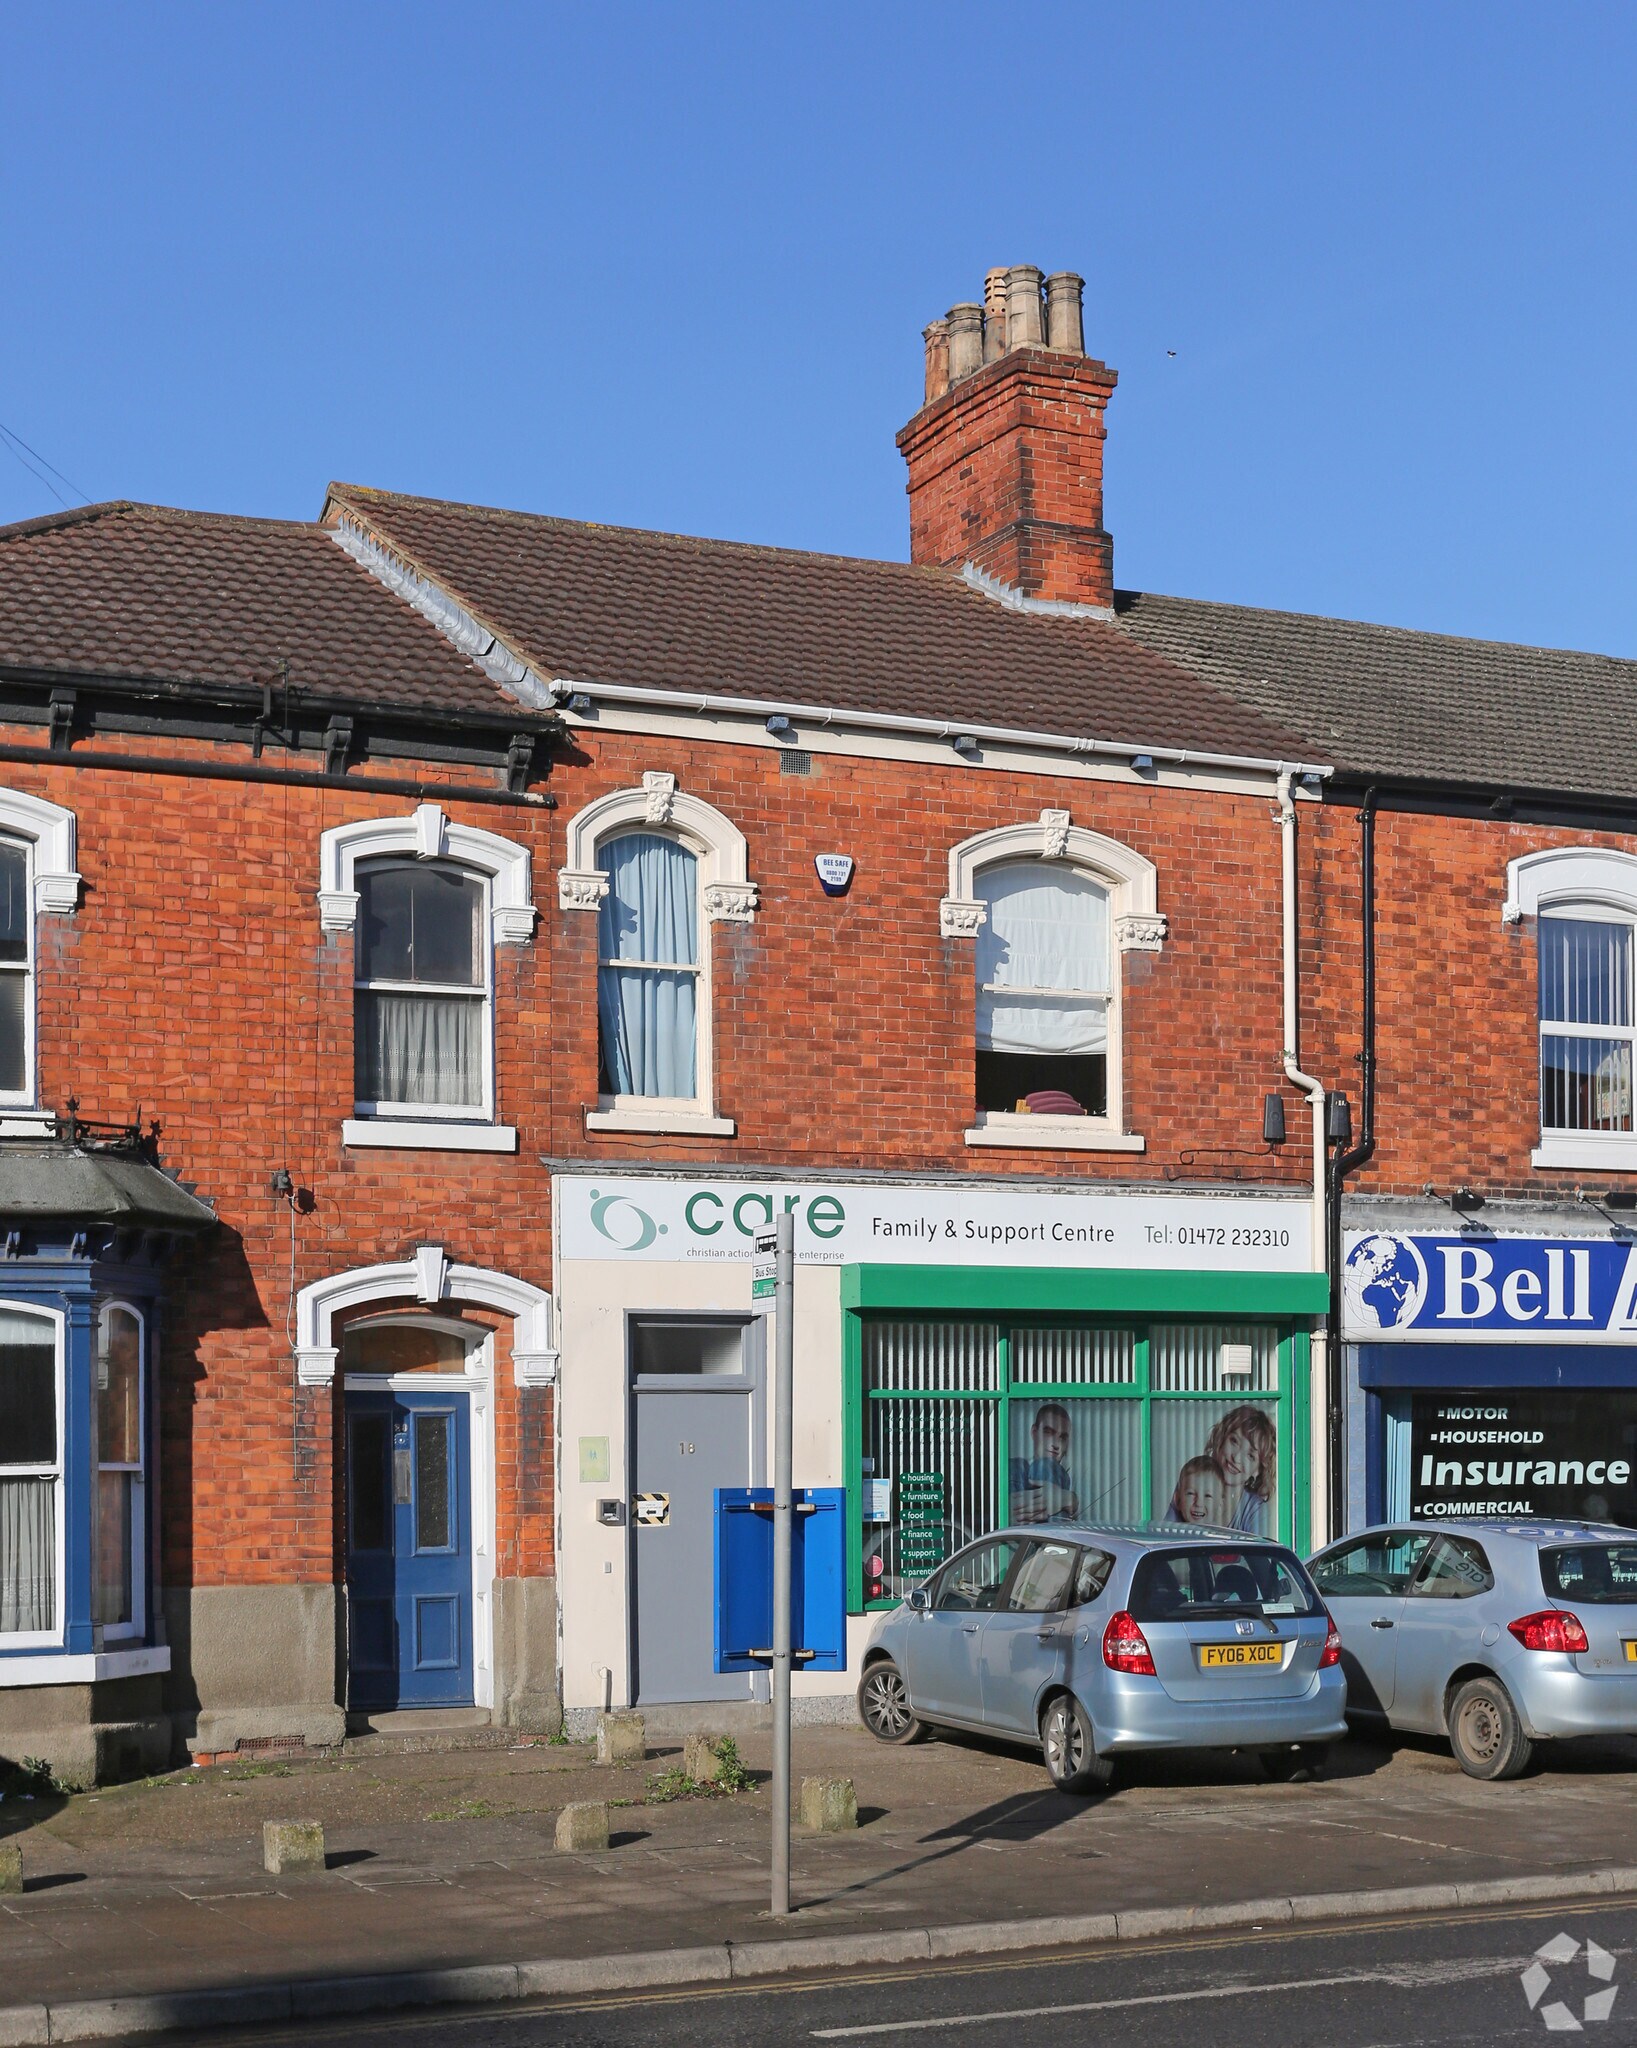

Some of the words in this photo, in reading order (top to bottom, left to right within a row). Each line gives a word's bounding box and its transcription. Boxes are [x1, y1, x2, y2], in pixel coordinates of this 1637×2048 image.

[835, 860, 849, 868] SAFE
[685, 1191, 846, 1239] care
[872, 1217, 938, 1242] Family
[945, 1221, 958, 1238] &
[965, 1220, 1045, 1245] Support
[1051, 1223, 1115, 1242] Centre
[1145, 1226, 1173, 1244] Tel:
[1178, 1227, 1225, 1246] 01472
[1231, 1229, 1290, 1247] 232310
[686, 1247, 726, 1259] christian
[799, 1251, 845, 1261] enterprise
[755, 1268, 765, 1278] Bus
[1436, 1246, 1594, 1321] Bell
[1446, 1407, 1508, 1420] MOTOR
[1439, 1431, 1544, 1444] HOUSEHOLD
[679, 1442, 695, 1455] 18
[1420, 1454, 1630, 1486] Insurance
[908, 1474, 934, 1483] housing
[908, 1492, 938, 1500] furniture
[1423, 1501, 1533, 1515] COMMERCIAL
[908, 1511, 924, 1519] food
[908, 1530, 933, 1538] finance
[908, 1549, 936, 1558] support
[1207, 1647, 1244, 1664] FY06
[1250, 1646, 1275, 1661] XOC
